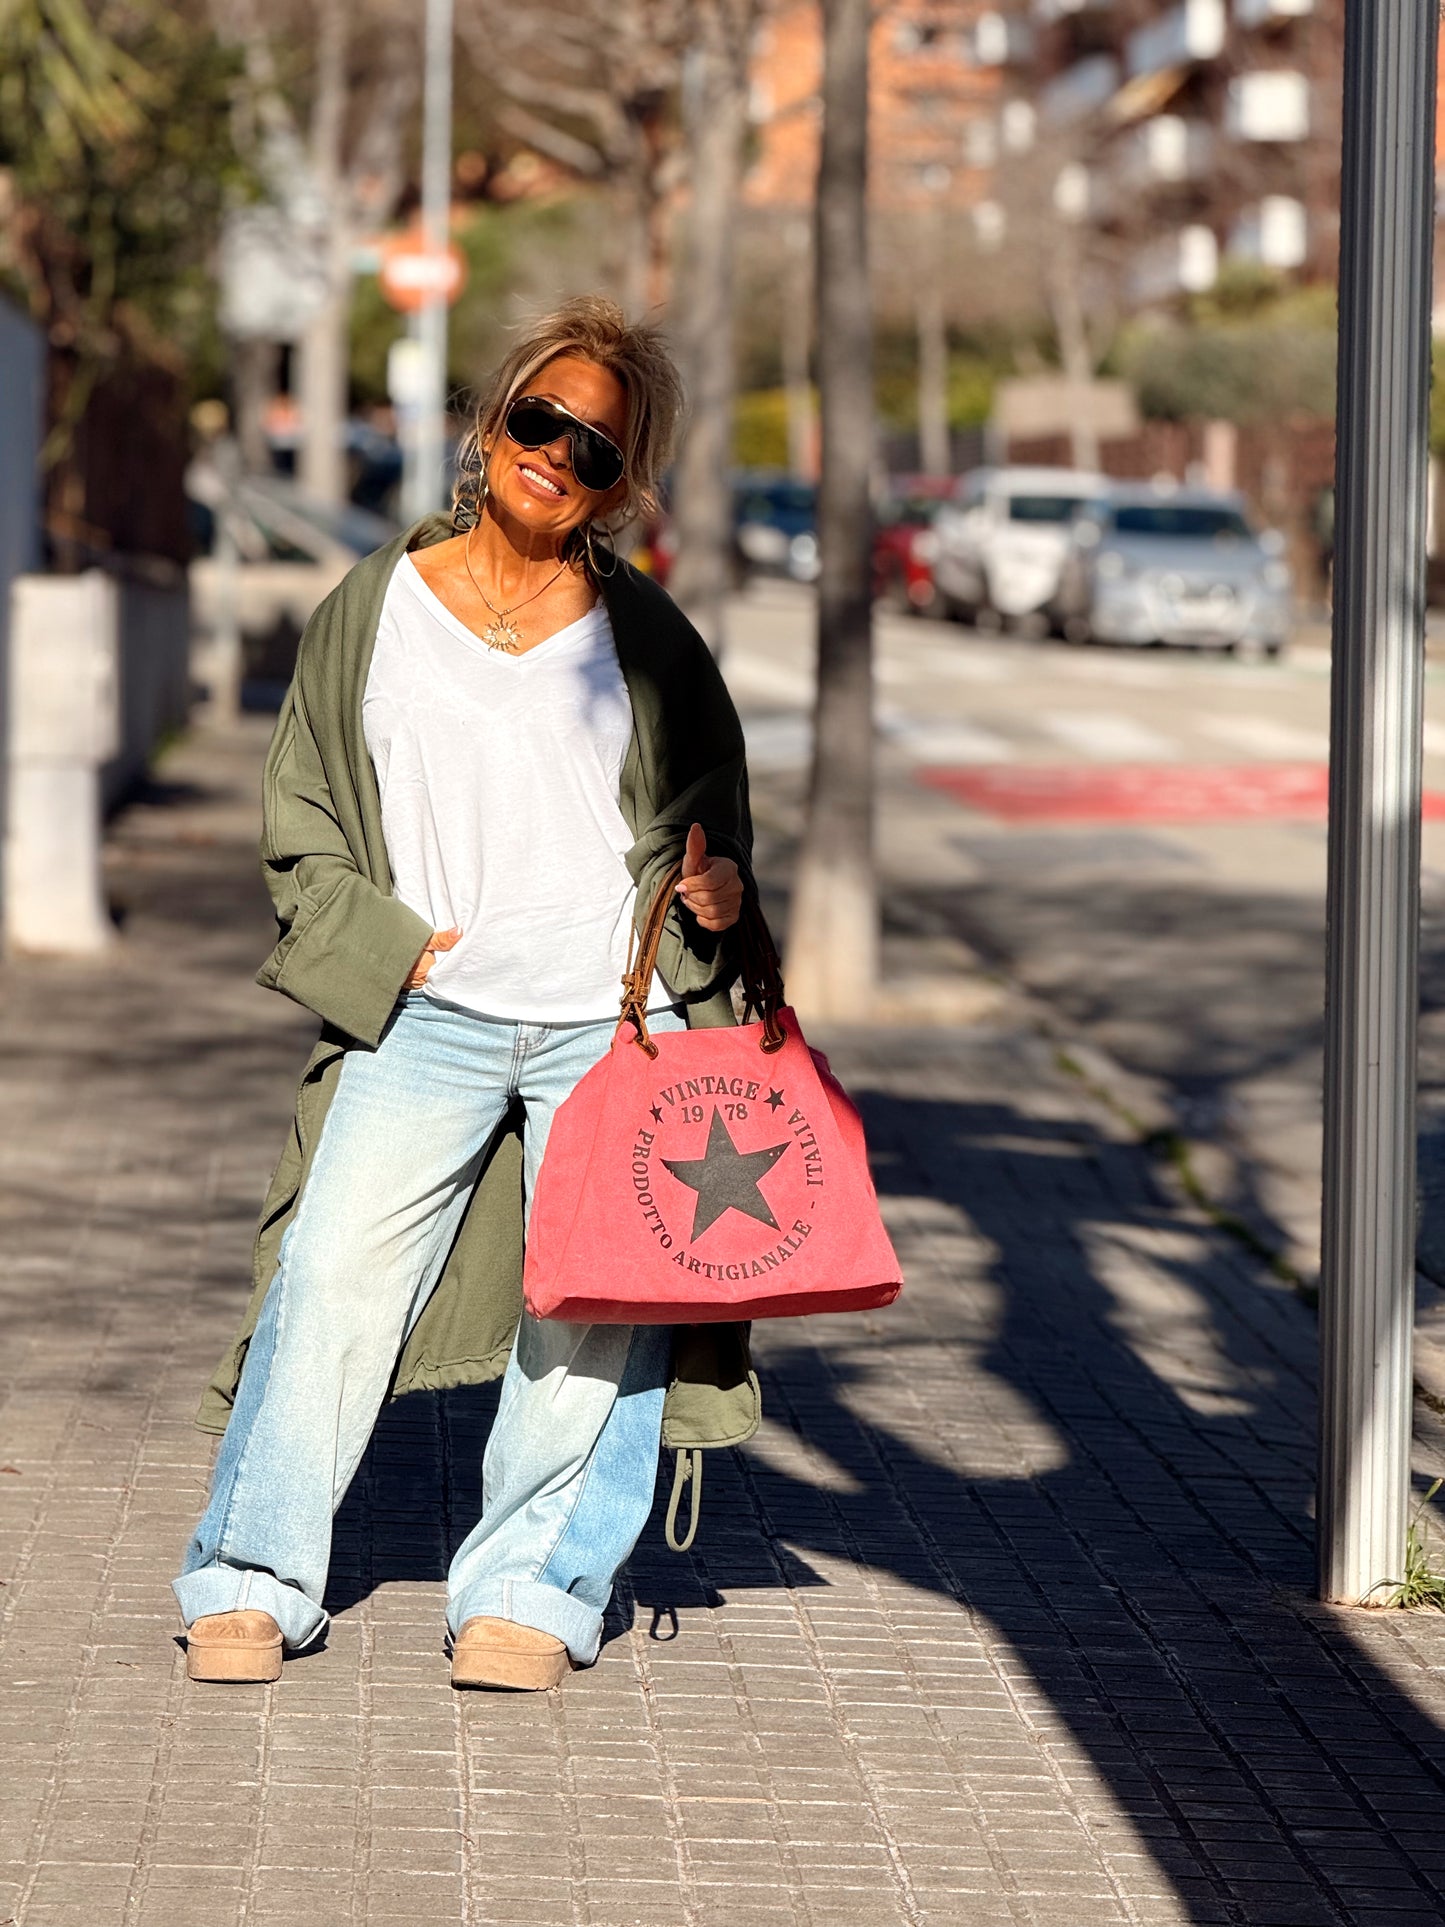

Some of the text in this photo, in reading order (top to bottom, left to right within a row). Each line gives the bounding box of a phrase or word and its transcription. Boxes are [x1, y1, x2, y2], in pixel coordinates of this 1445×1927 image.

[660, 1076, 761, 1106] VINTAGE
[681, 1103, 748, 1123] 19 78
[632, 1128, 673, 1249] PRODOTTO
[672, 1219, 812, 1281] ARTIGIANALE
[787, 1108, 824, 1186] ITALIA
